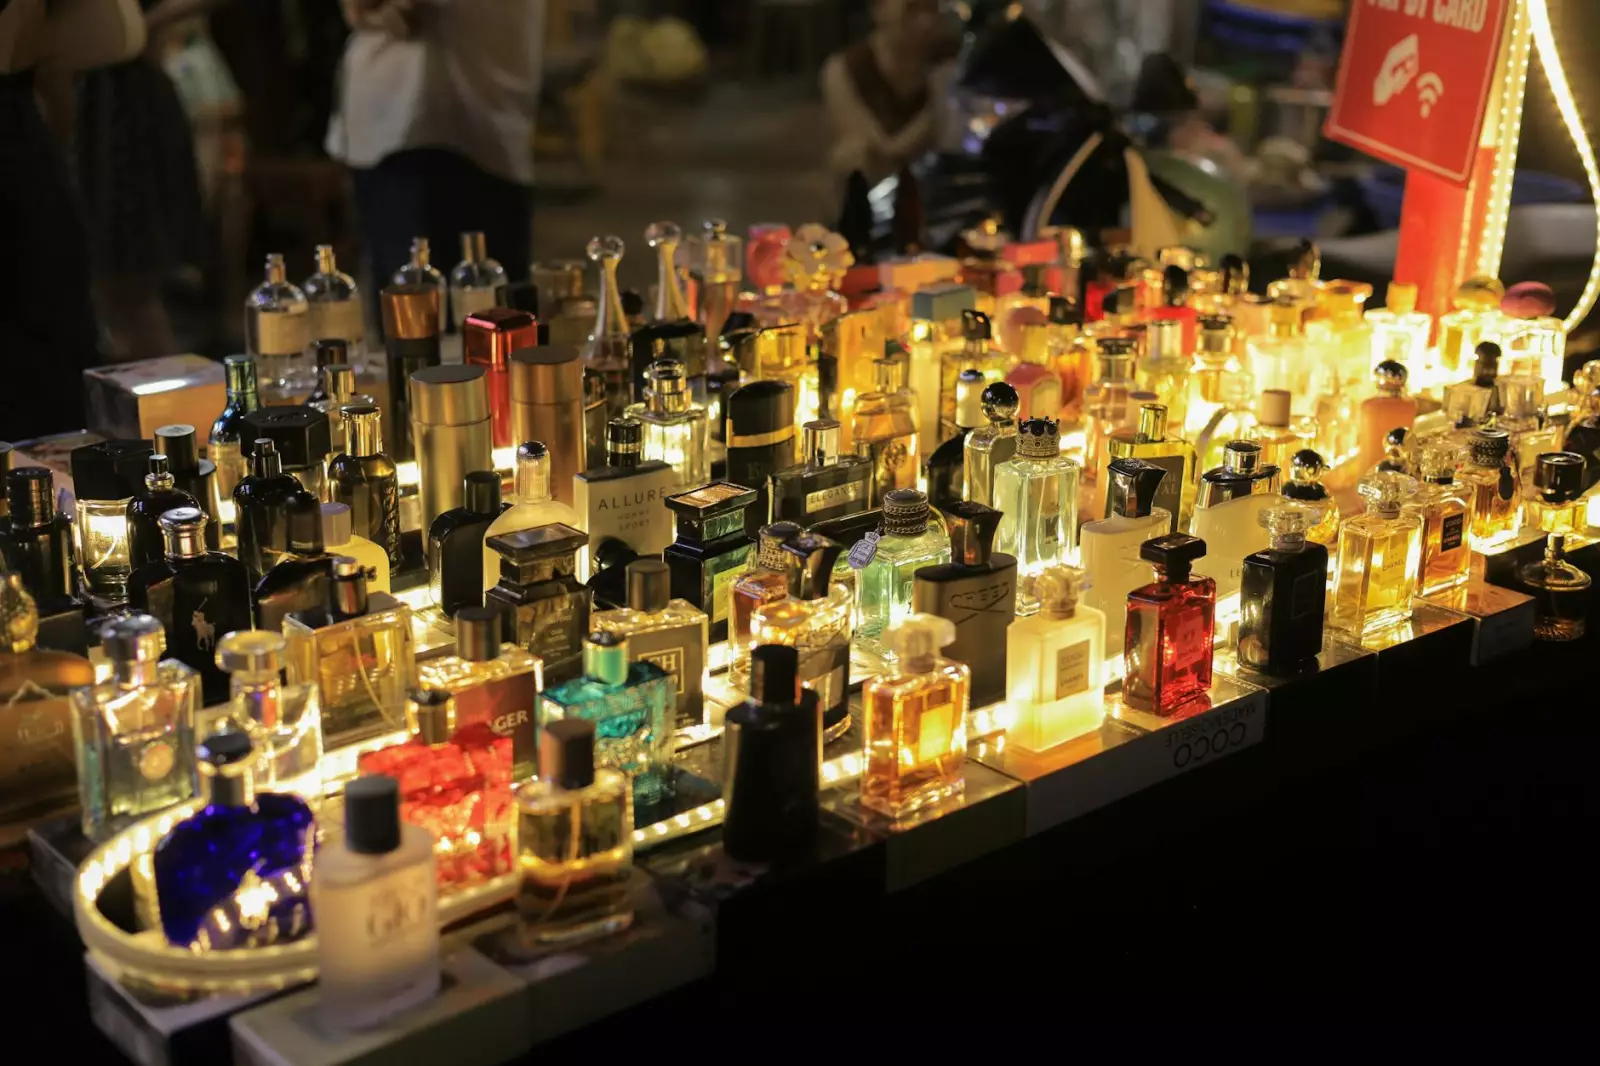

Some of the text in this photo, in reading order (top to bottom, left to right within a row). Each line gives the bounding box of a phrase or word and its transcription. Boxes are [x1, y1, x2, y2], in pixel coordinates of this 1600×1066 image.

[598, 486, 667, 513] ALLURE
[618, 519, 650, 531] SPORT
[1173, 722, 1247, 769] COCO
